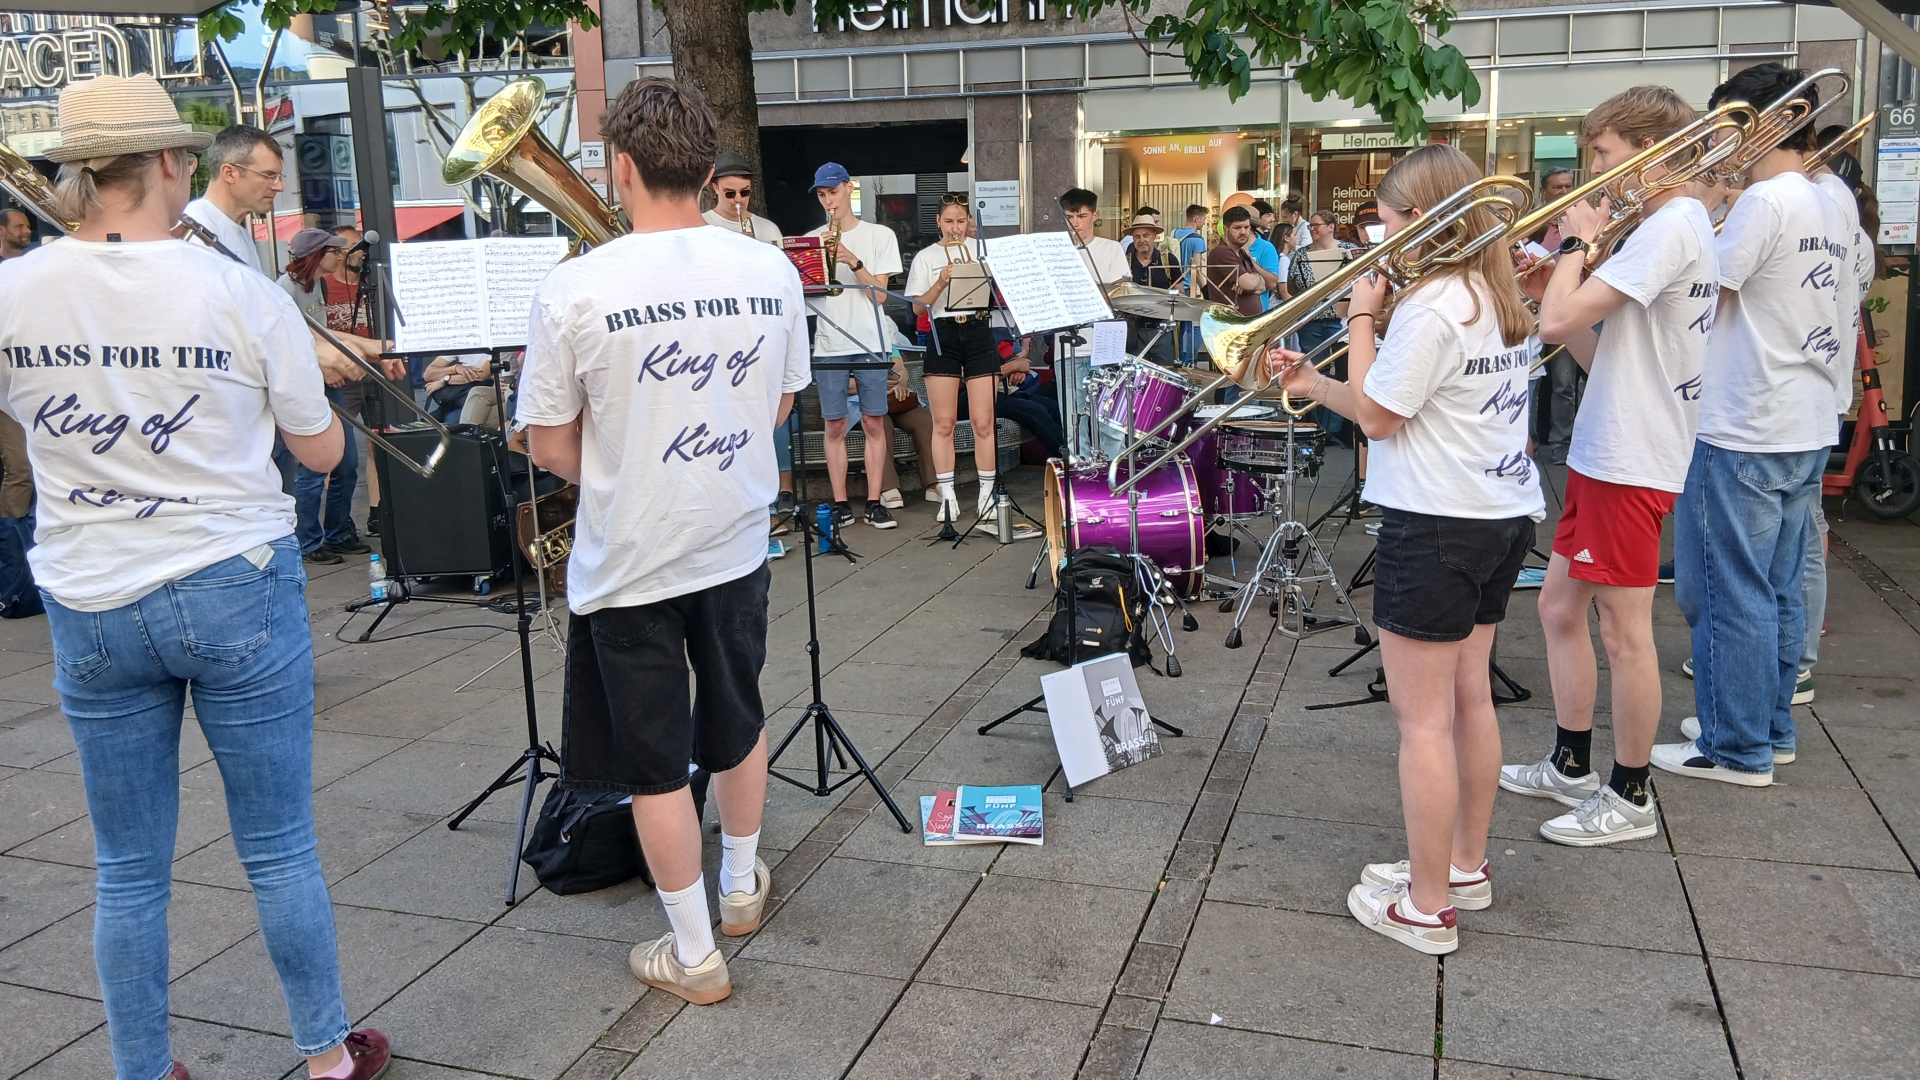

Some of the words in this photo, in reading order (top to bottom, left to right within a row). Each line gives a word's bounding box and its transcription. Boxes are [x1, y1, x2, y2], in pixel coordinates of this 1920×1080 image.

[1890, 107, 1916, 126] 66
[587, 149, 599, 157] 70
[1142, 145, 1167, 155] SONNE
[1168, 143, 1182, 153] AN,
[1183, 145, 1206, 155] BRILLE
[1208, 138, 1223, 148] AUF
[1332, 186, 1376, 199] fielman
[604, 301, 688, 334] BRASS
[694, 297, 741, 319] FOR
[746, 296, 784, 316] THE
[100, 345, 162, 369] FOR
[172, 345, 232, 372] THE
[637, 340, 719, 392] King
[726, 334, 766, 388] of
[1462, 351, 1512, 376] BRASS
[1479, 378, 1528, 425] King
[33, 392, 131, 455] King
[140, 393, 201, 455] of
[661, 421, 755, 472] Kings
[1105, 695, 1125, 709] FÜNF
[1114, 735, 1146, 755] BRASS
[976, 822, 1024, 830] BRASS
